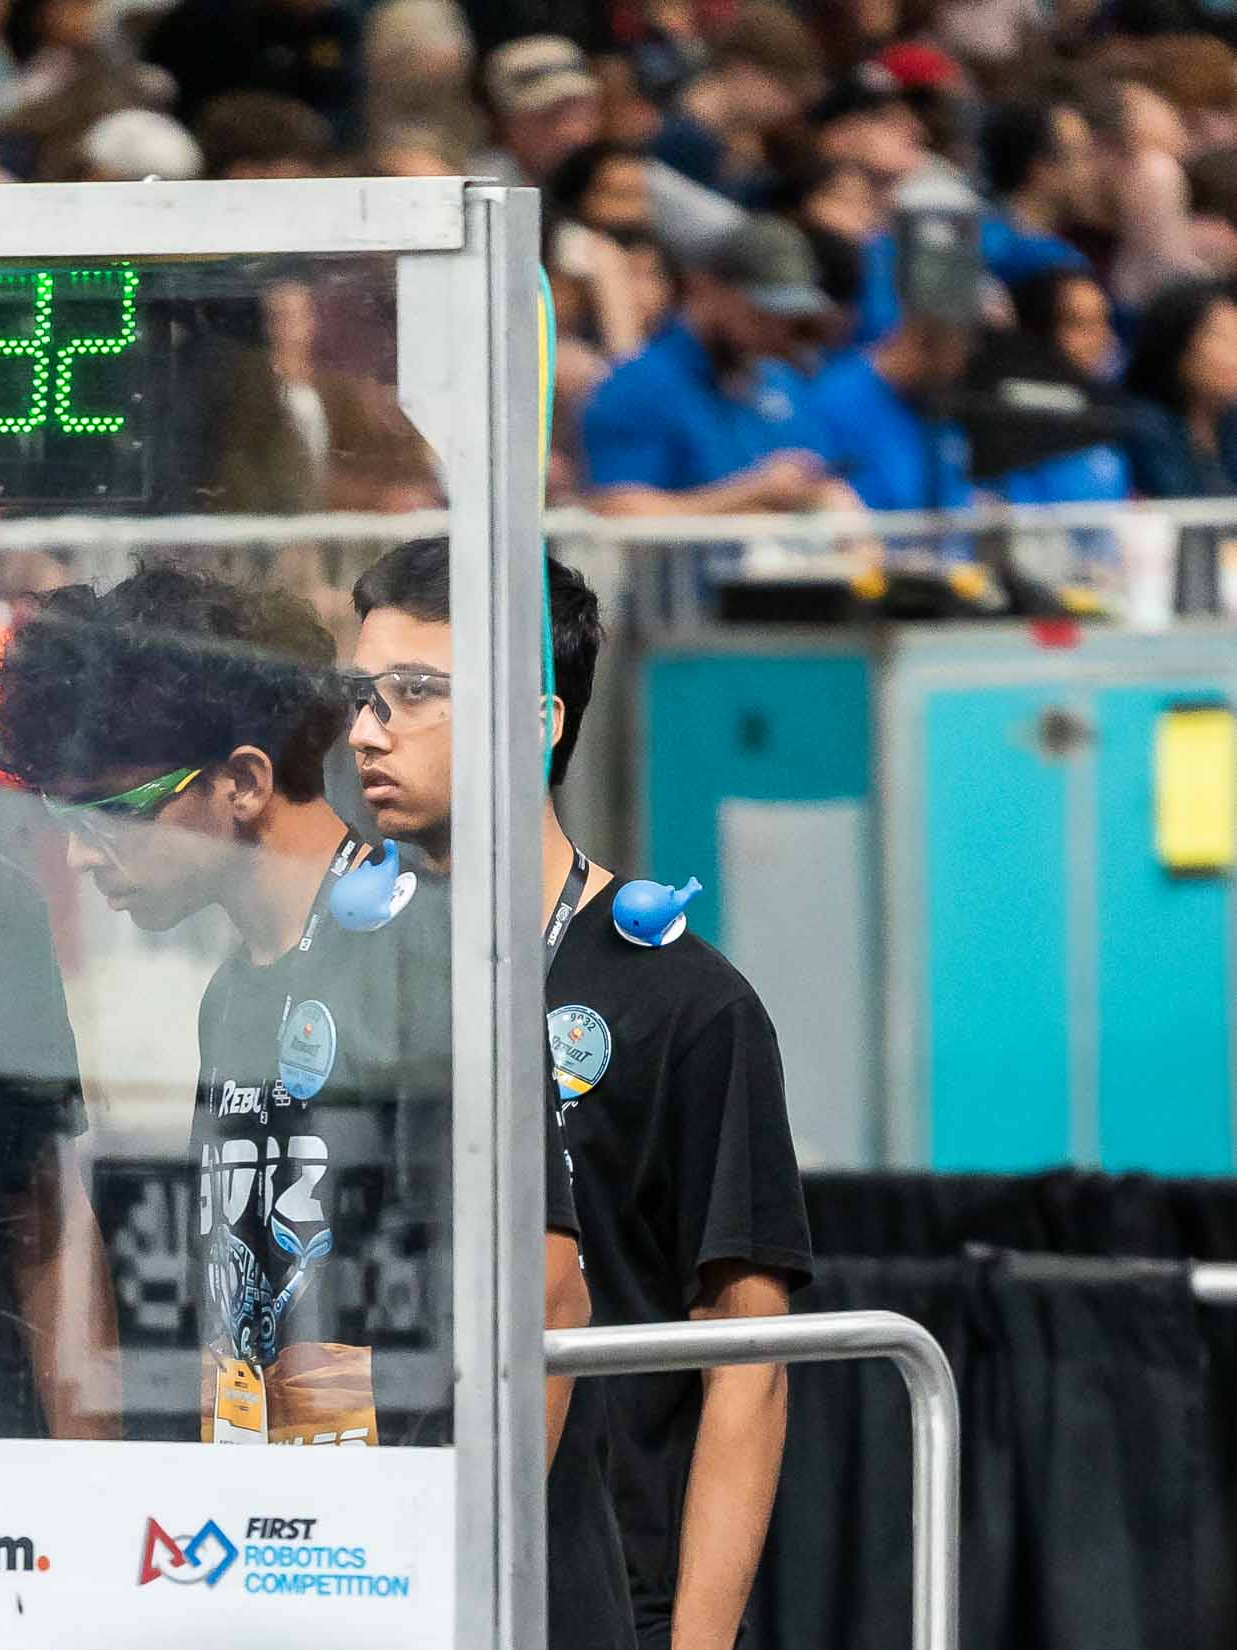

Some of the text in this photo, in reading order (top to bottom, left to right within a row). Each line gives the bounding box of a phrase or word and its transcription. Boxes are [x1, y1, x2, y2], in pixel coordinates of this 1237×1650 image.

[570, 1012, 597, 1032] 9032
[245, 1517, 317, 1540] FIRST
[244, 1545, 367, 1569] ROBOTICS
[244, 1573, 410, 1597] COMPETITION
